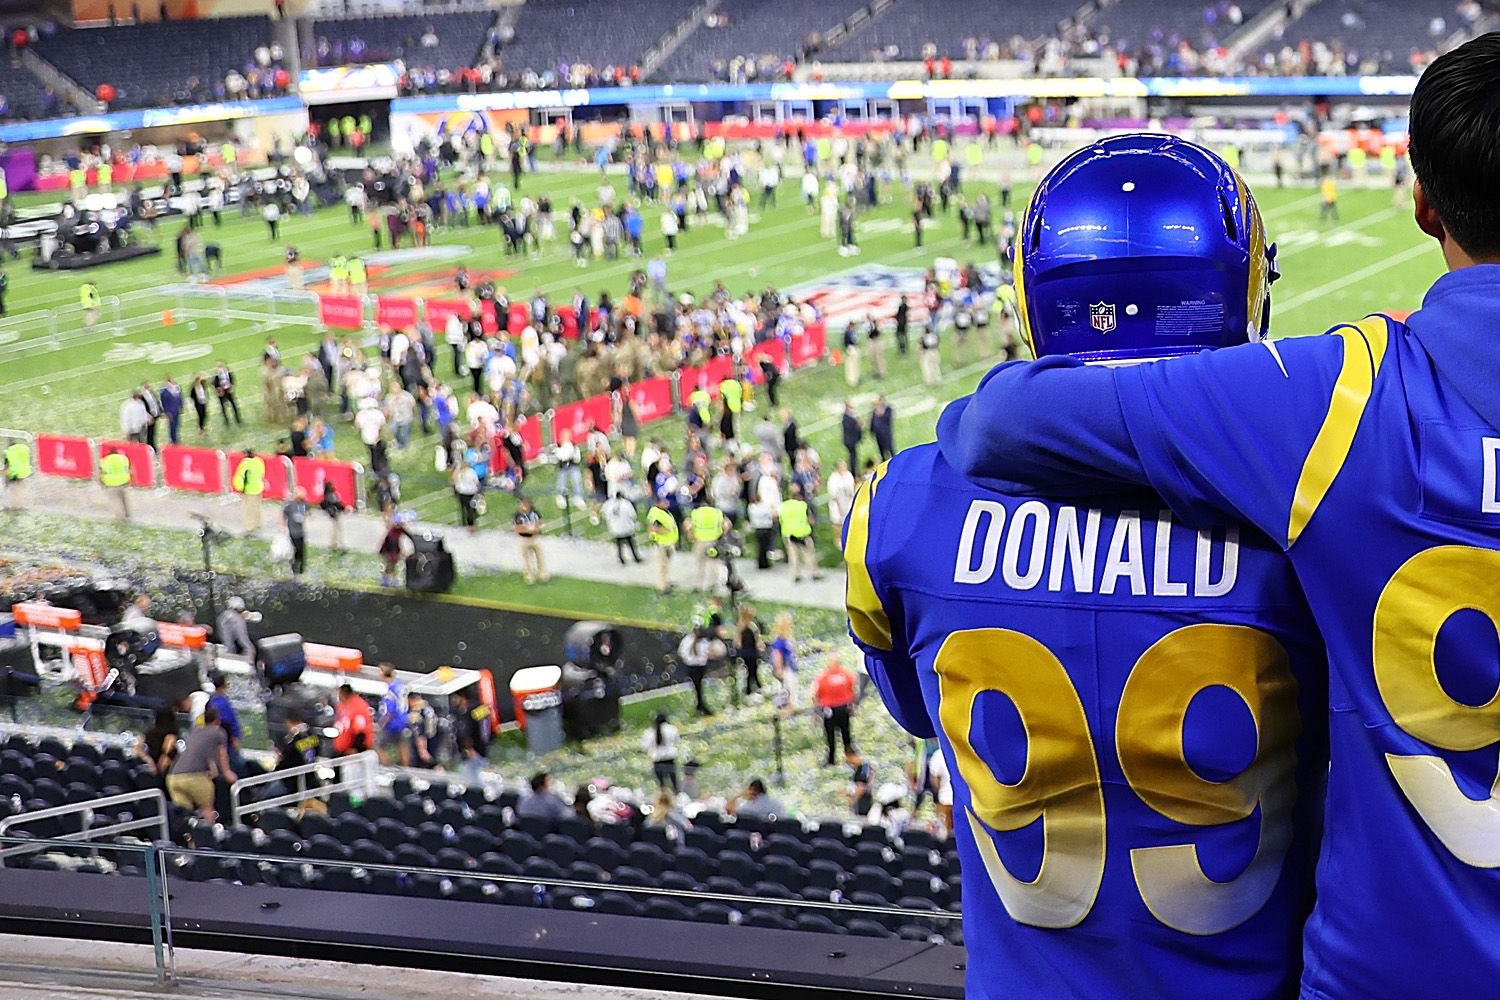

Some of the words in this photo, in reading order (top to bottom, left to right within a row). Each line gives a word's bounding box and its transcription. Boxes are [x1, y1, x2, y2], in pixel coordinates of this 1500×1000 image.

[1093, 315, 1114, 330] NFL
[953, 499, 1240, 598] DONALD
[933, 622, 1301, 937] 99
